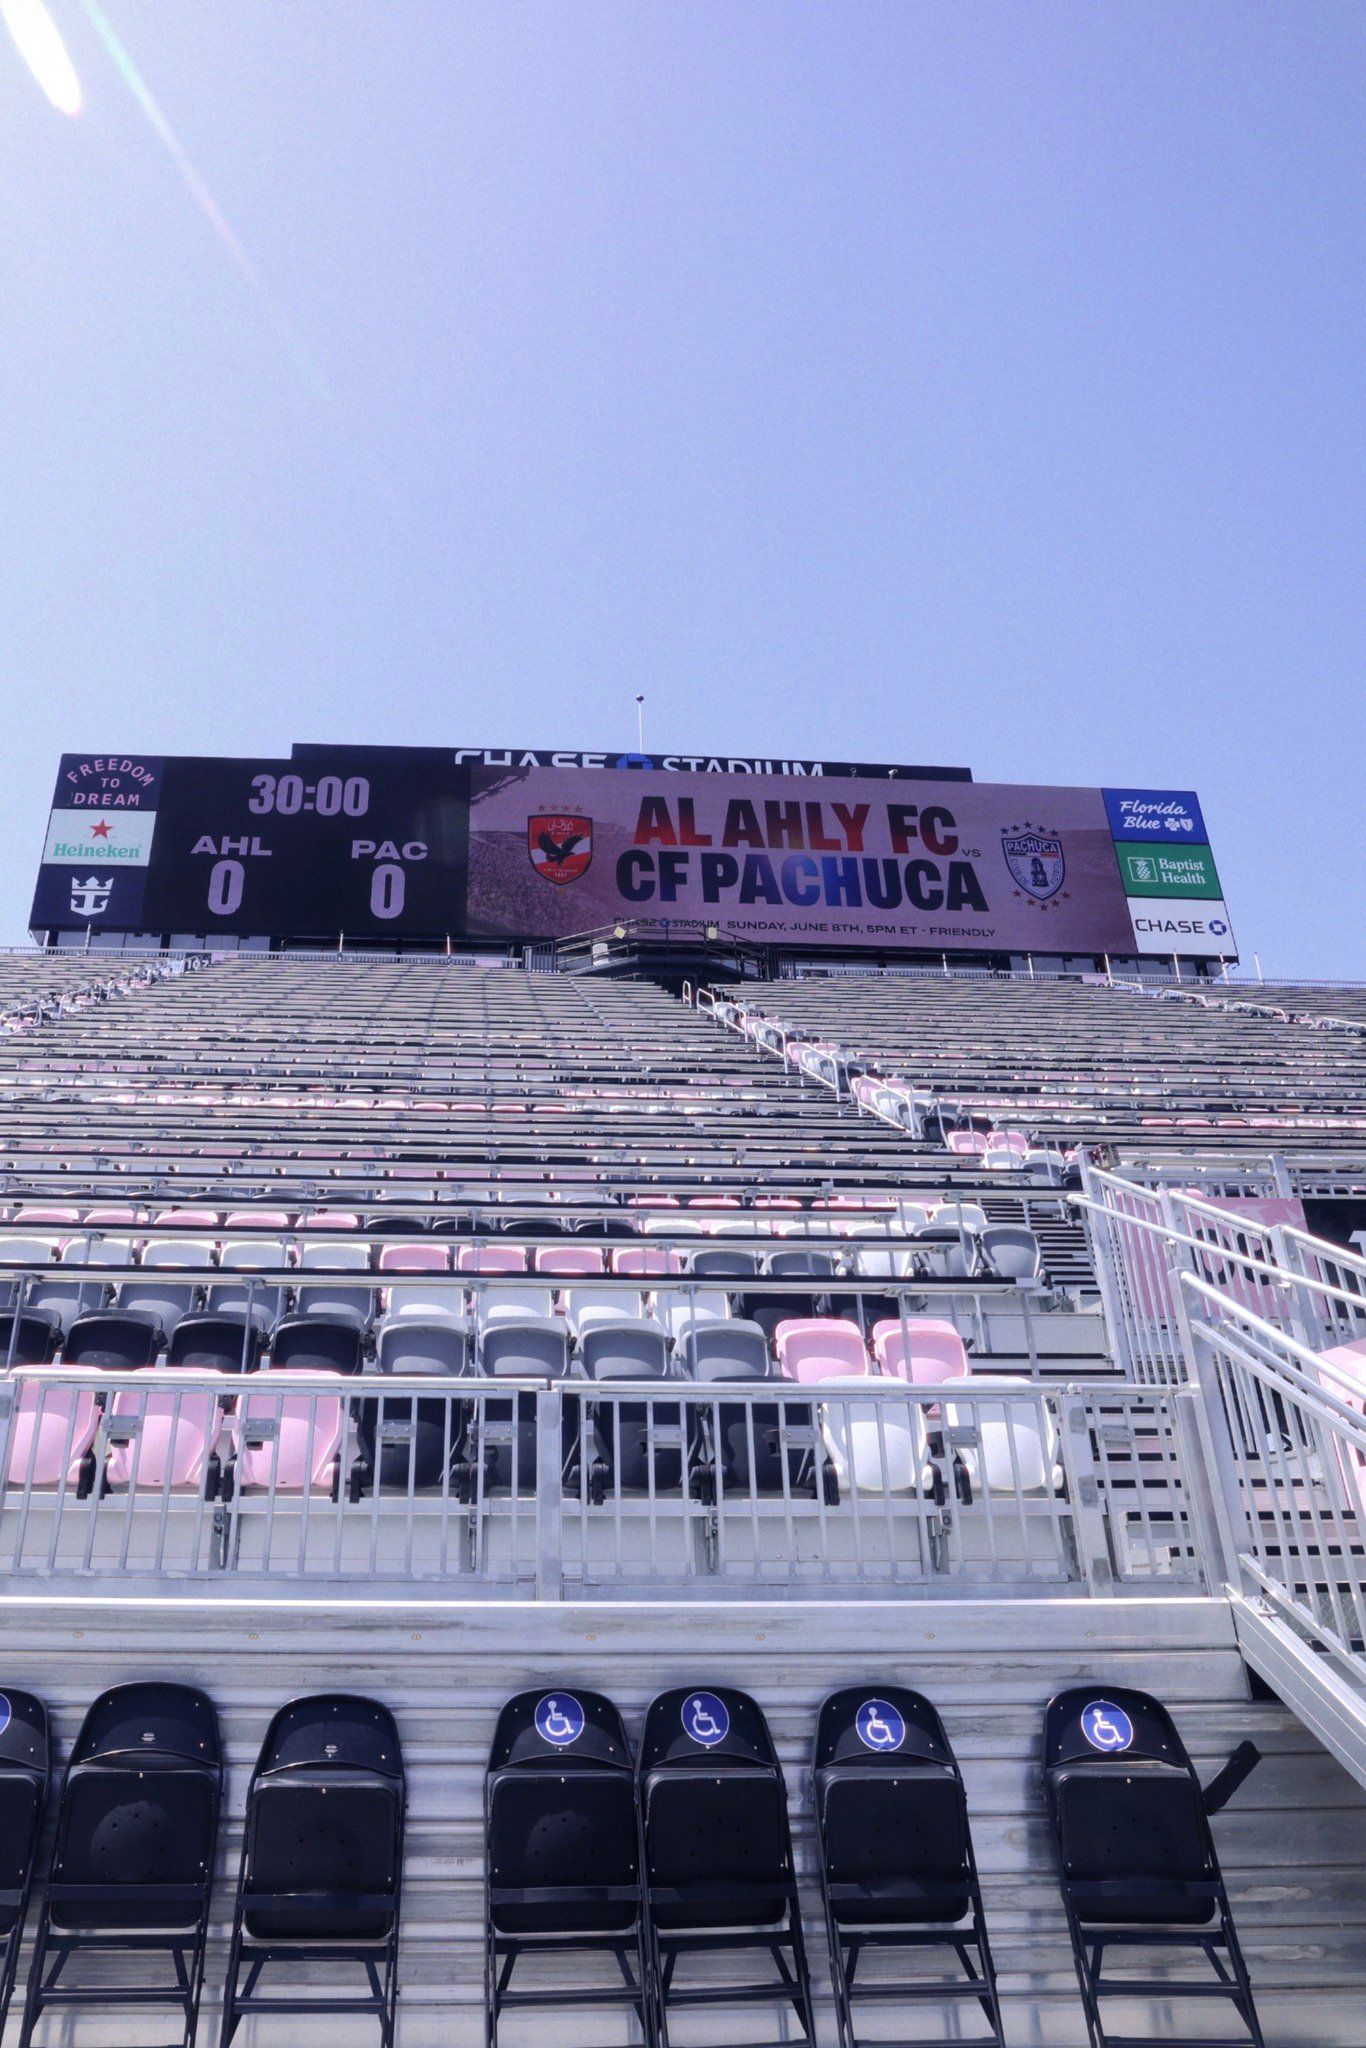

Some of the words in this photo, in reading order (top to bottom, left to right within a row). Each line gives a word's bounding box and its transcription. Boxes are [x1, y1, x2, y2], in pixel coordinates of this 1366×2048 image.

[67, 758, 155, 787] FREEDOM
[101, 777, 120, 788] TO
[73, 792, 140, 806] DREAM
[248, 774, 370, 817] 30:00
[1120, 800, 1187, 815] Florida
[633, 795, 712, 847] AL
[722, 798, 870, 852] AHLY
[887, 803, 959, 856] FC
[1123, 816, 1161, 829] Blue
[53, 843, 141, 858] Heineken
[190, 835, 272, 856] AHL
[351, 840, 428, 861] PAC
[1007, 839, 1058, 853] PACHUCA
[1158, 858, 1205, 872] Baptist
[616, 849, 689, 903] CF
[700, 852, 990, 912] PACHUCA
[1161, 872, 1206, 884] Health
[207, 859, 245, 915] 0
[370, 863, 406, 920] 0
[727, 920, 787, 932] SUNDAY,
[790, 922, 828, 932] JUNE
[832, 923, 863, 934] 8TH,
[867, 925, 896, 935] 5PM
[900, 926, 916, 935] ET
[930, 927, 996, 938] FRIENDLY
[1135, 919, 1205, 934] CHASE
